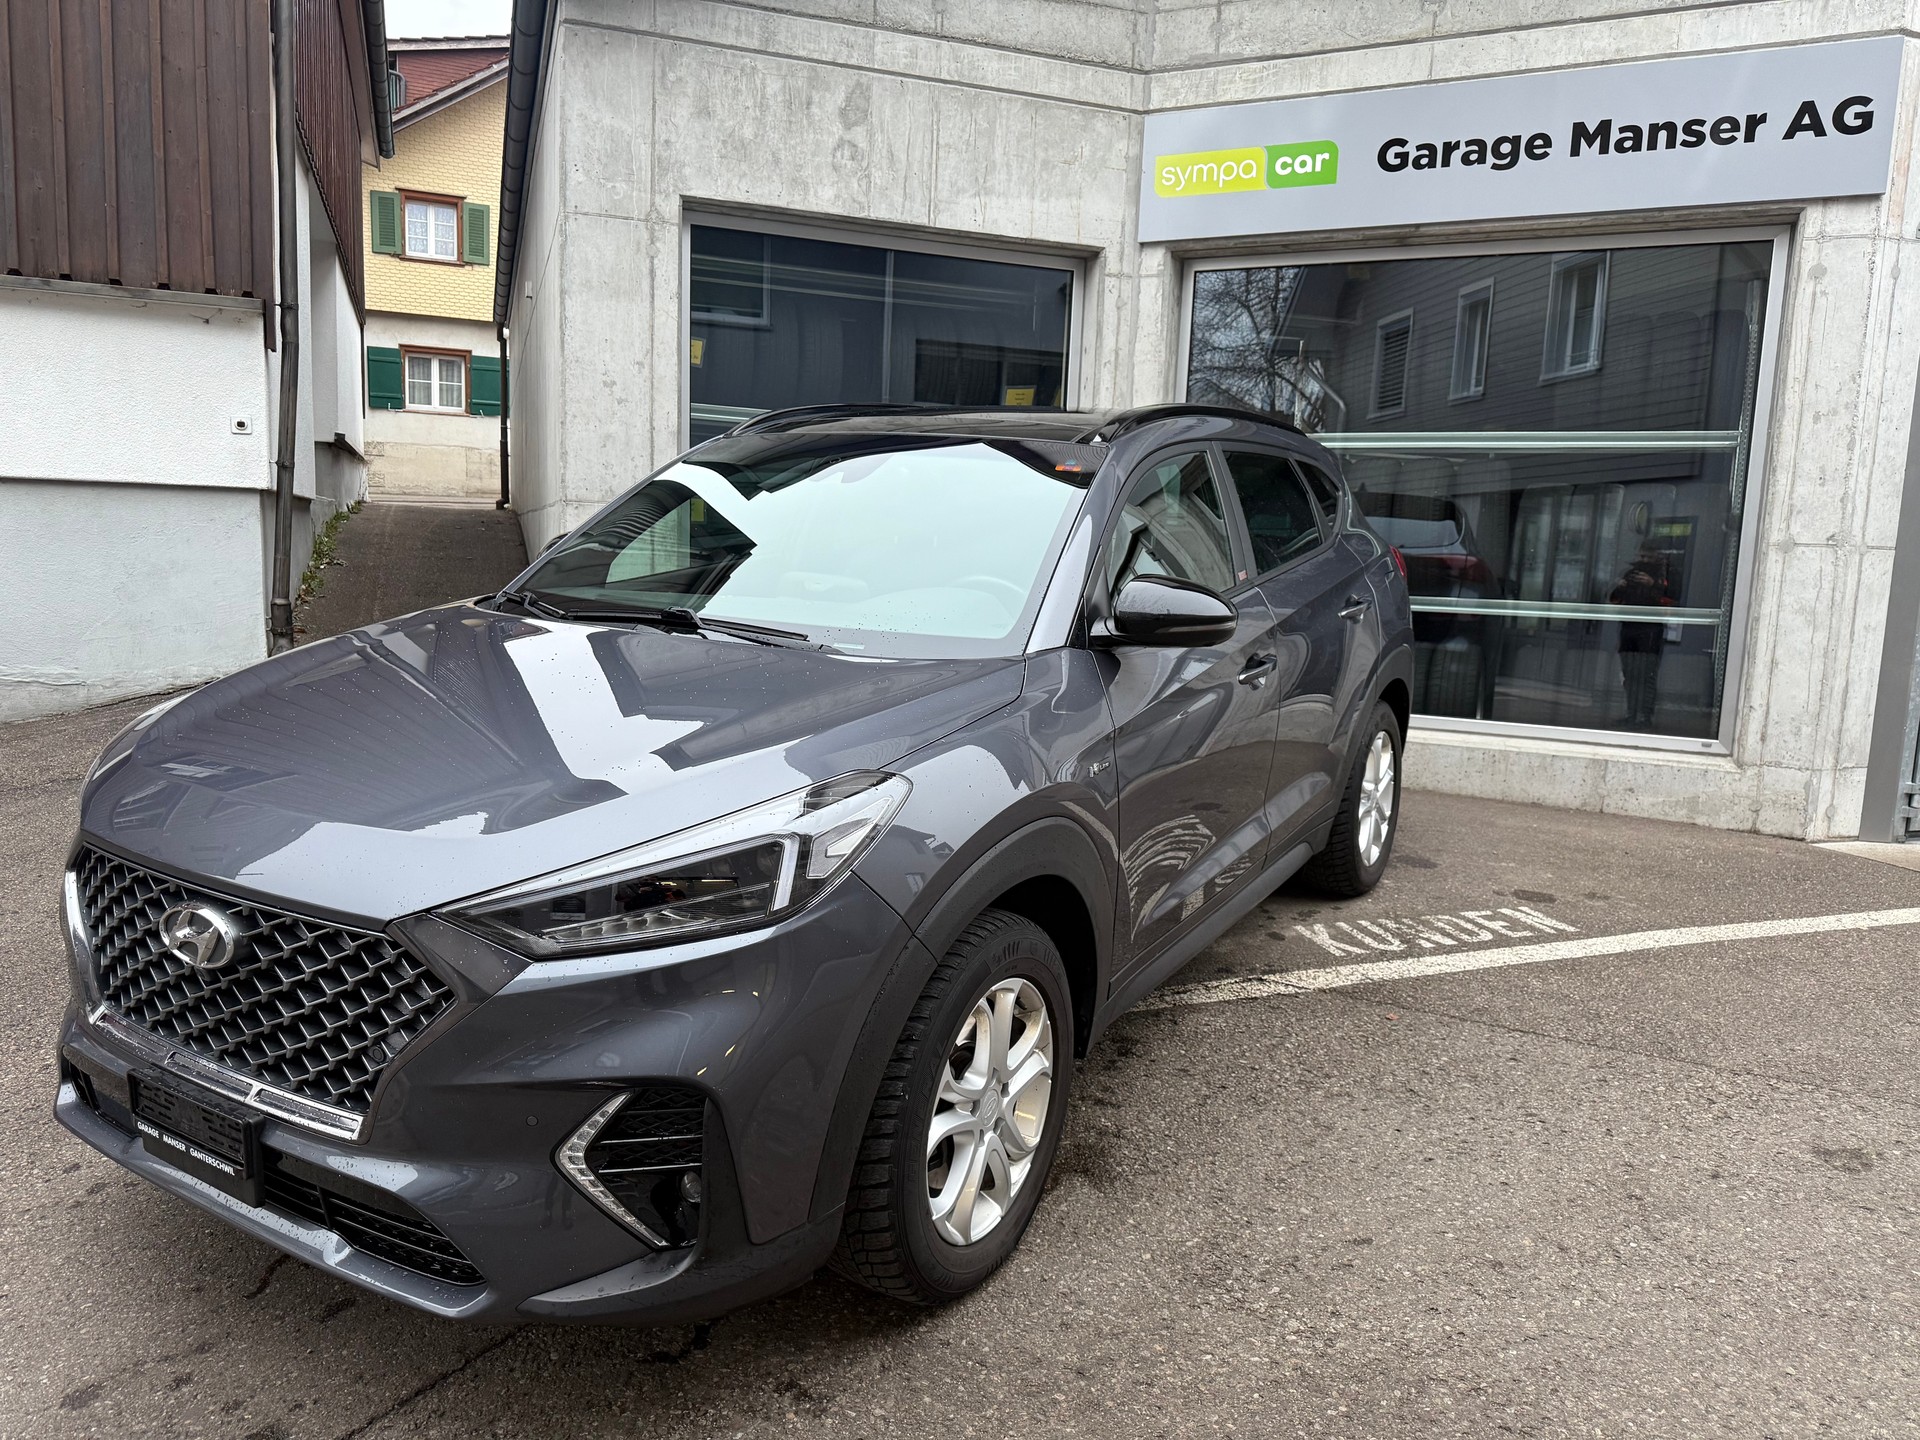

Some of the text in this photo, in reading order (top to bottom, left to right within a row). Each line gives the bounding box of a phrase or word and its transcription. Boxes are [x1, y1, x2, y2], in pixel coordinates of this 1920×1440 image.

[1377, 96, 1875, 173] Garage Manser AG
[1161, 153, 1330, 191] sympa car
[1294, 906, 1580, 957] KUNDEN
[137, 1121, 236, 1177] GARAGE MANSER GANTERSCHWIL
